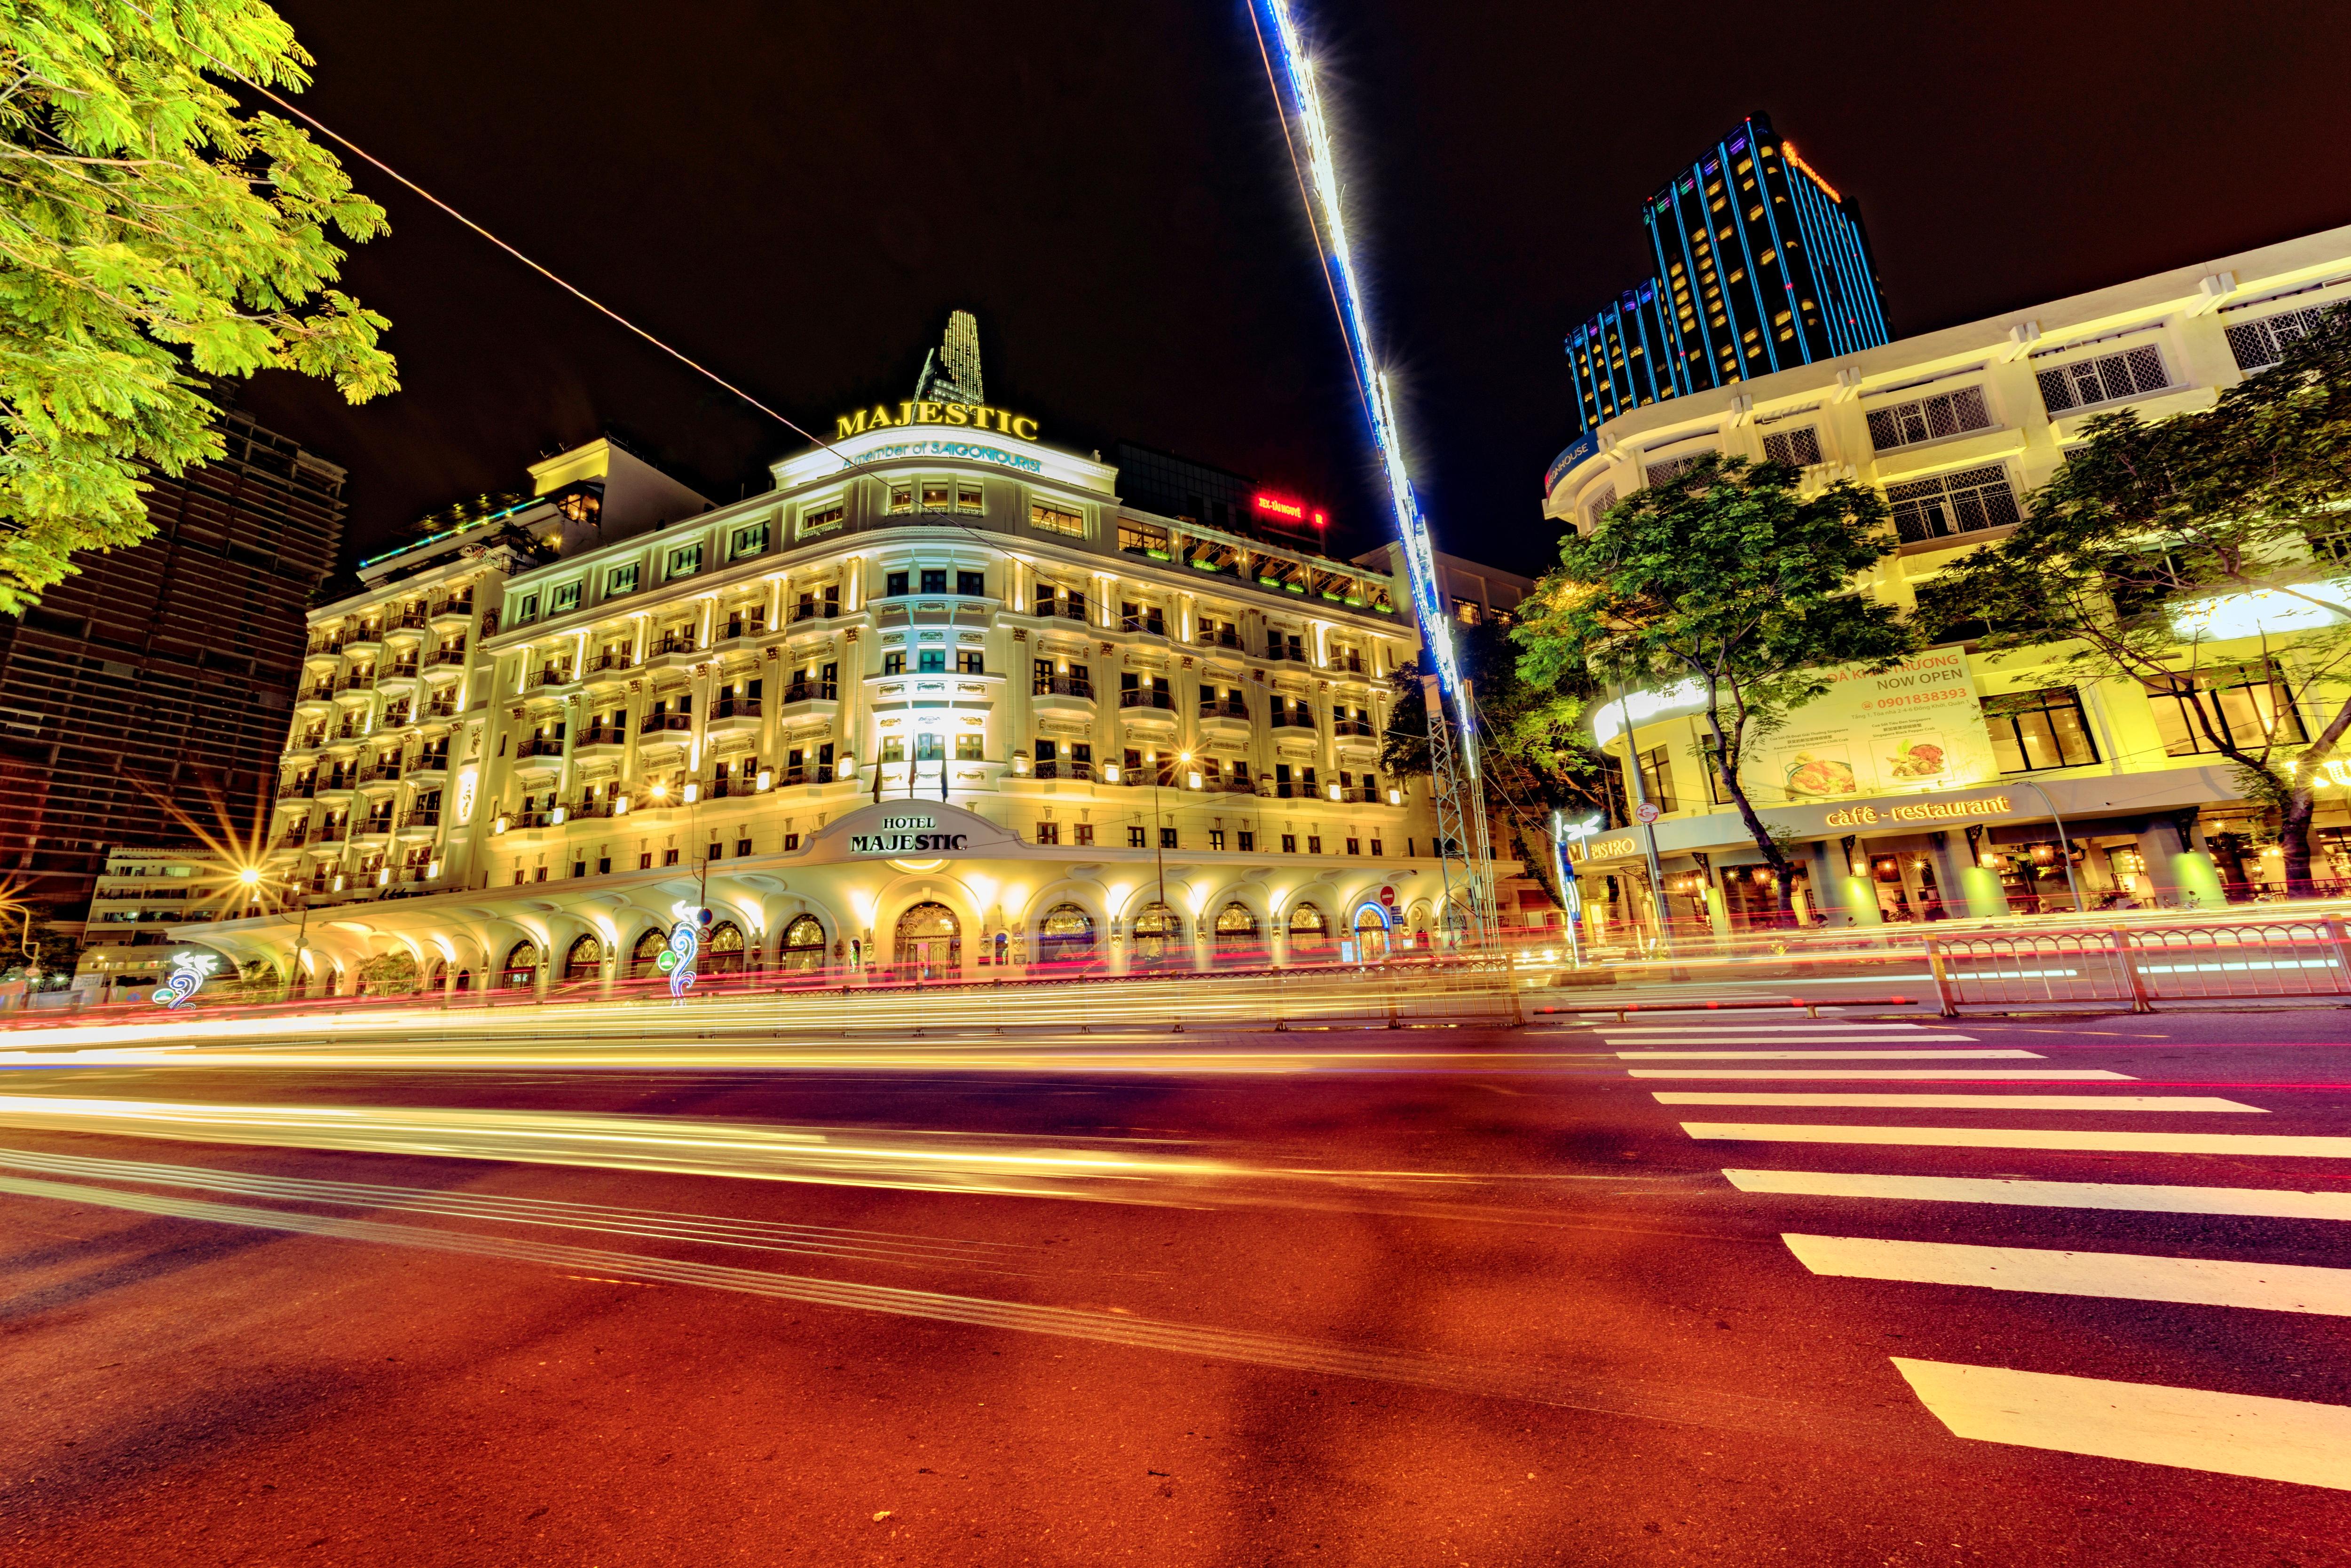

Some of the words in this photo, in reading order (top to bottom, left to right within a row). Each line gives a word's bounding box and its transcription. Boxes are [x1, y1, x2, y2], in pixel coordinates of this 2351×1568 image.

[836, 402, 1037, 440] MAJESTIC
[854, 444, 907, 465] member
[913, 442, 927, 455] of
[931, 441, 1041, 473] SAIGONTOURIST
[1877, 676, 1914, 690] NOW
[1919, 669, 1963, 683] OPEN
[1877, 688, 1967, 708] 0901838393
[1893, 797, 2010, 820] restaurant
[884, 818, 936, 828] HOTEL
[851, 835, 967, 851] MAJESTIC
[1590, 839, 1633, 859] BISTRO
